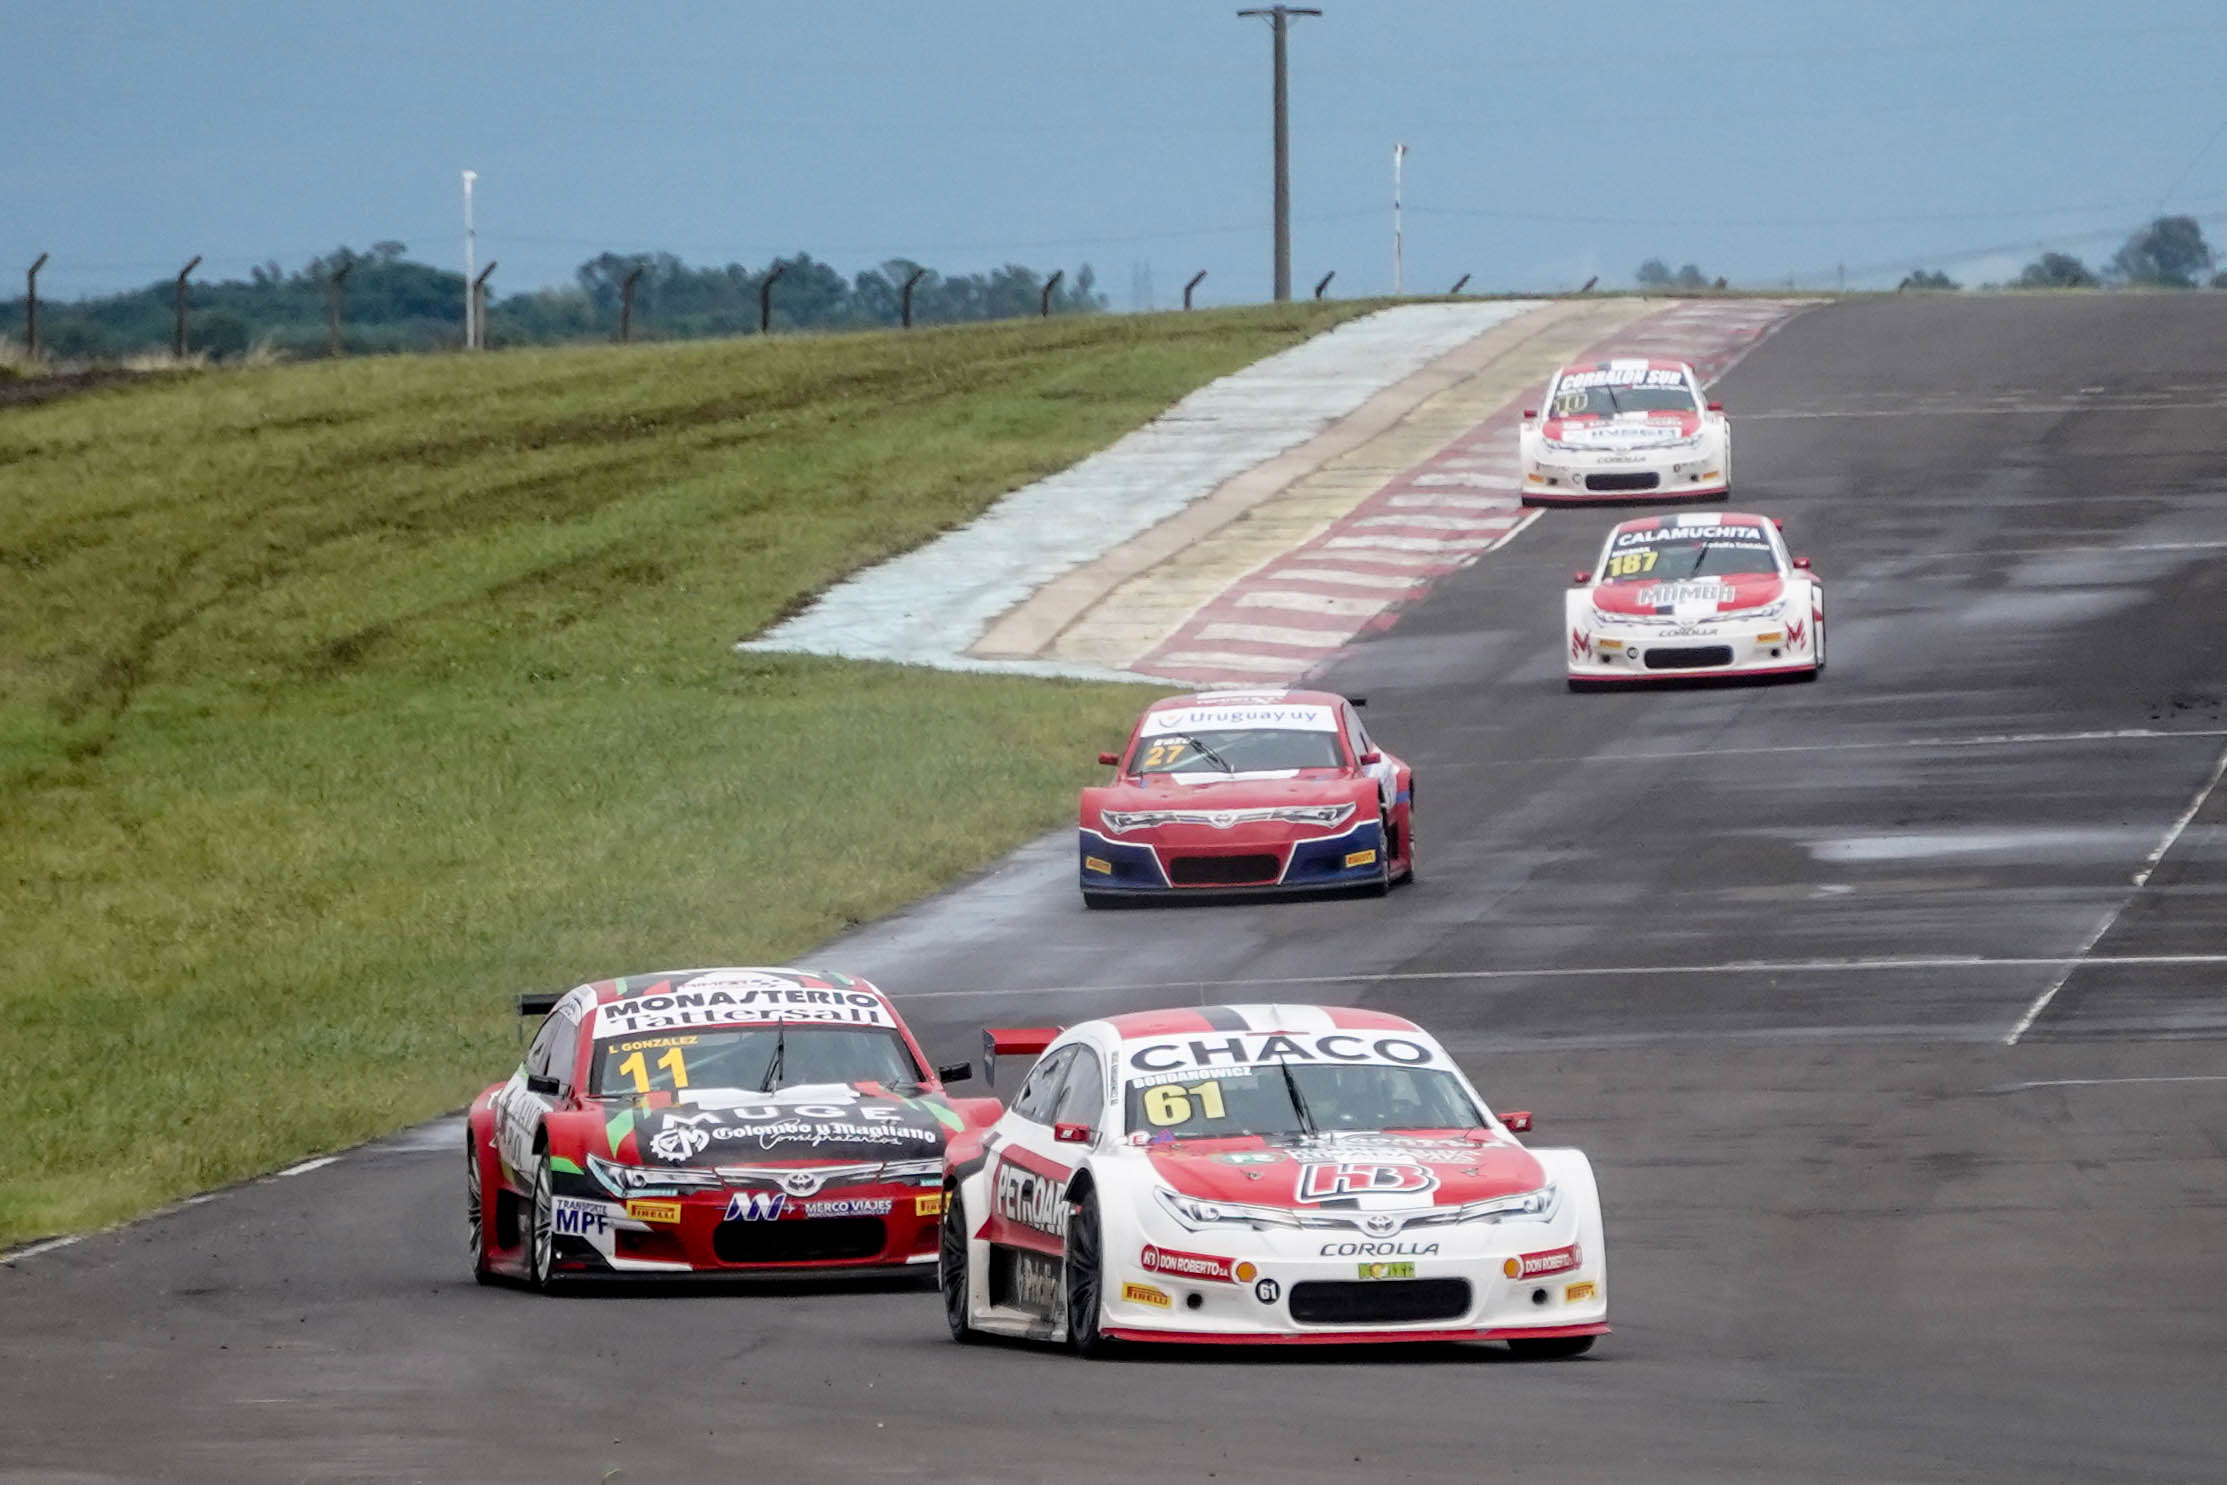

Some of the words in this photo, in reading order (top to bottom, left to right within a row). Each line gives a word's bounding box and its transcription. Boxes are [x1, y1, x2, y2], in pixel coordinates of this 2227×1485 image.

[1618, 526, 1761, 547] CALAMUCHITA
[1609, 551, 1659, 577] 187
[1144, 744, 1185, 767] 27
[604, 990, 880, 1019] MONASTERIO
[608, 1044, 618, 1054] L
[621, 1035, 699, 1051] GONZALEZ
[1130, 1036, 1433, 1072] CHACO
[619, 1047, 689, 1093] 11
[1144, 1080, 1226, 1126] 61
[557, 1200, 607, 1215] TRANSPORTE
[631, 1204, 676, 1219] PIRELLI
[805, 1202, 849, 1214] MERCO
[852, 1199, 892, 1211] VIAJES
[556, 1209, 607, 1235] MPF
[1320, 1242, 1439, 1256] COROLLA
[1160, 1255, 1176, 1269] DON
[1177, 1257, 1220, 1276] ROBERTO
[1525, 1260, 1542, 1273] DON
[1127, 1286, 1169, 1305] PIRELLI
[1259, 1283, 1277, 1300] 61
